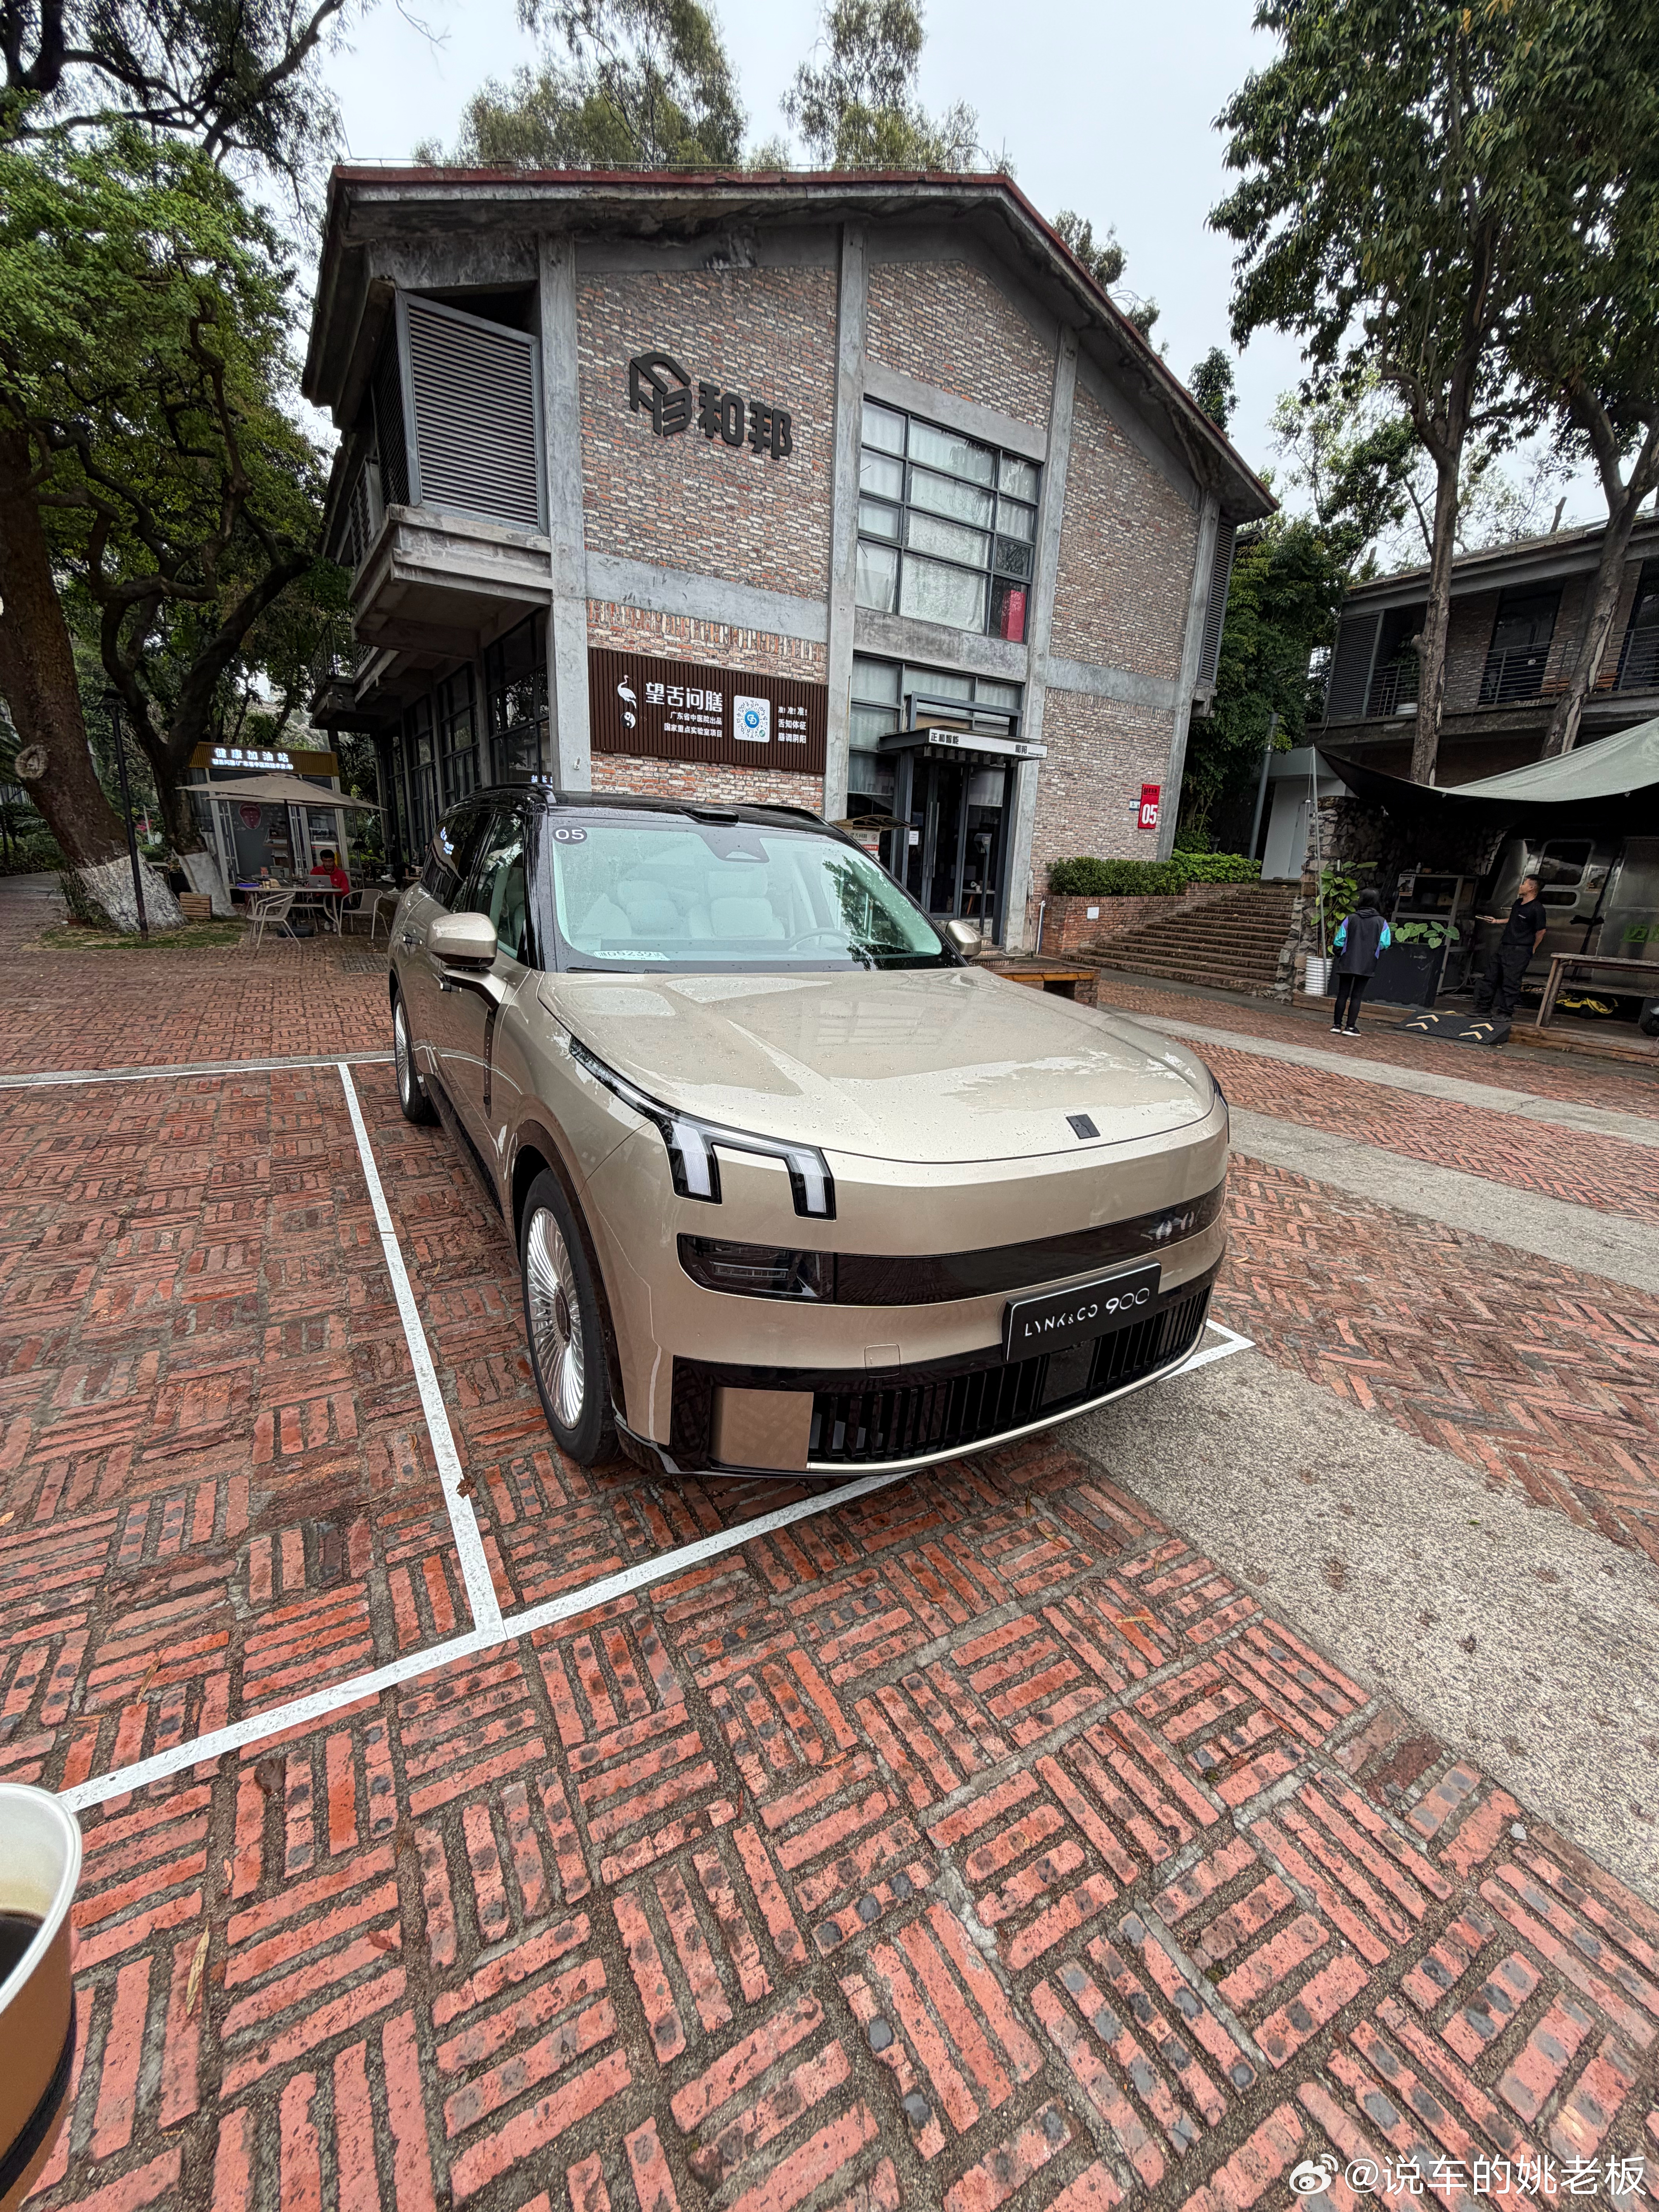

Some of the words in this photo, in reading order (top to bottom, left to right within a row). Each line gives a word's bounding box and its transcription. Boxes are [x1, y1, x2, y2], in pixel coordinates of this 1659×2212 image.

[698, 382, 793, 459] 和邦
[646, 682, 723, 712] 望舌问膳
[670, 711, 722, 725] 广东省中医院出品
[778, 719, 806, 730] 舌知体征
[664, 723, 722, 737] 国家重点实验室项目
[214, 747, 289, 763] 健康加油站
[1015, 745, 1027, 754] 和邦
[1142, 804, 1158, 824] 05
[555, 829, 584, 840] 05
[1025, 1304, 1097, 1336] LYNK&CO
[1106, 1288, 1149, 1315] 900
